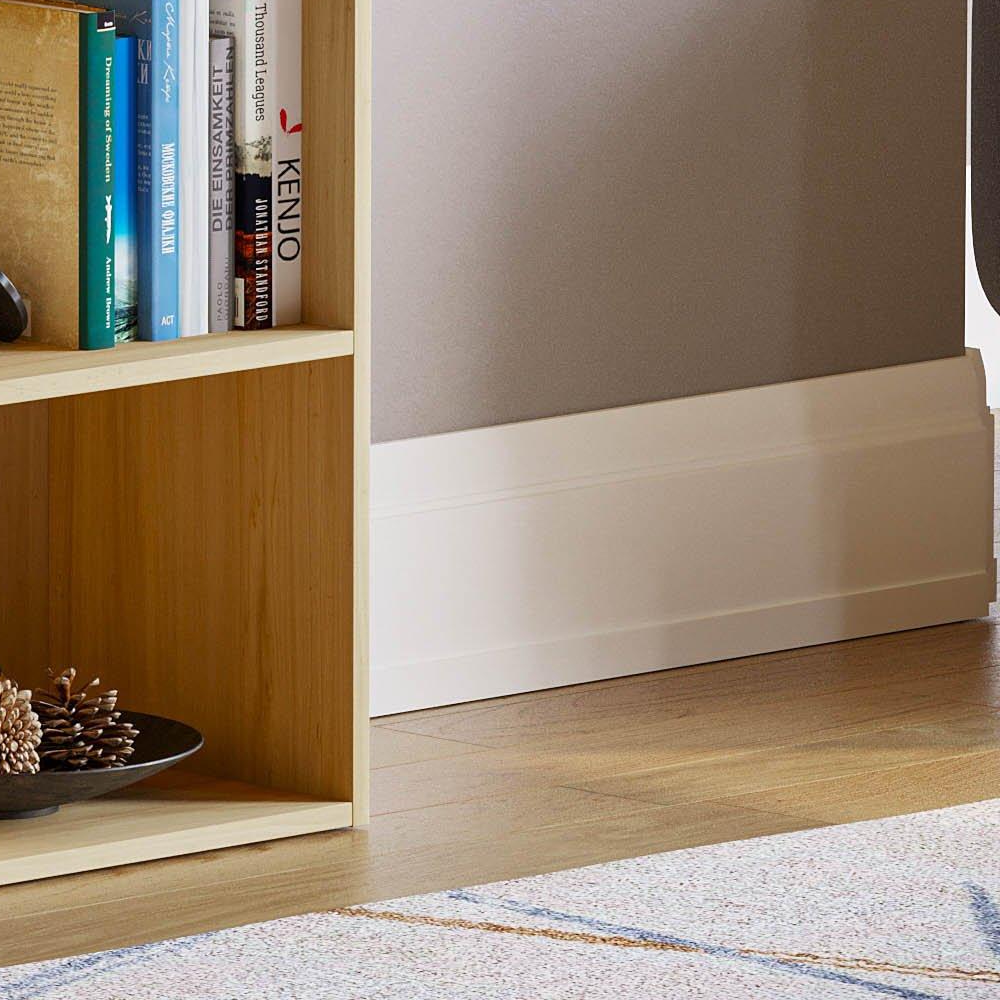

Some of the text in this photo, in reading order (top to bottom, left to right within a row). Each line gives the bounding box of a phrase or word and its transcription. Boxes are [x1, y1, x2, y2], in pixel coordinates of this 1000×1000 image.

[104, 57, 112, 117] Dreaming
[252, 3, 268, 122] Thousand Leagues
[105, 120, 112, 132] of
[212, 66, 223, 232] DIE EINSAMKEIT
[161, 143, 175, 254] МОСКОВСКИЕ ФИАЛКИ
[277, 158, 301, 261] KENJO
[255, 198, 268, 322] JONATHAN STANDFORD
